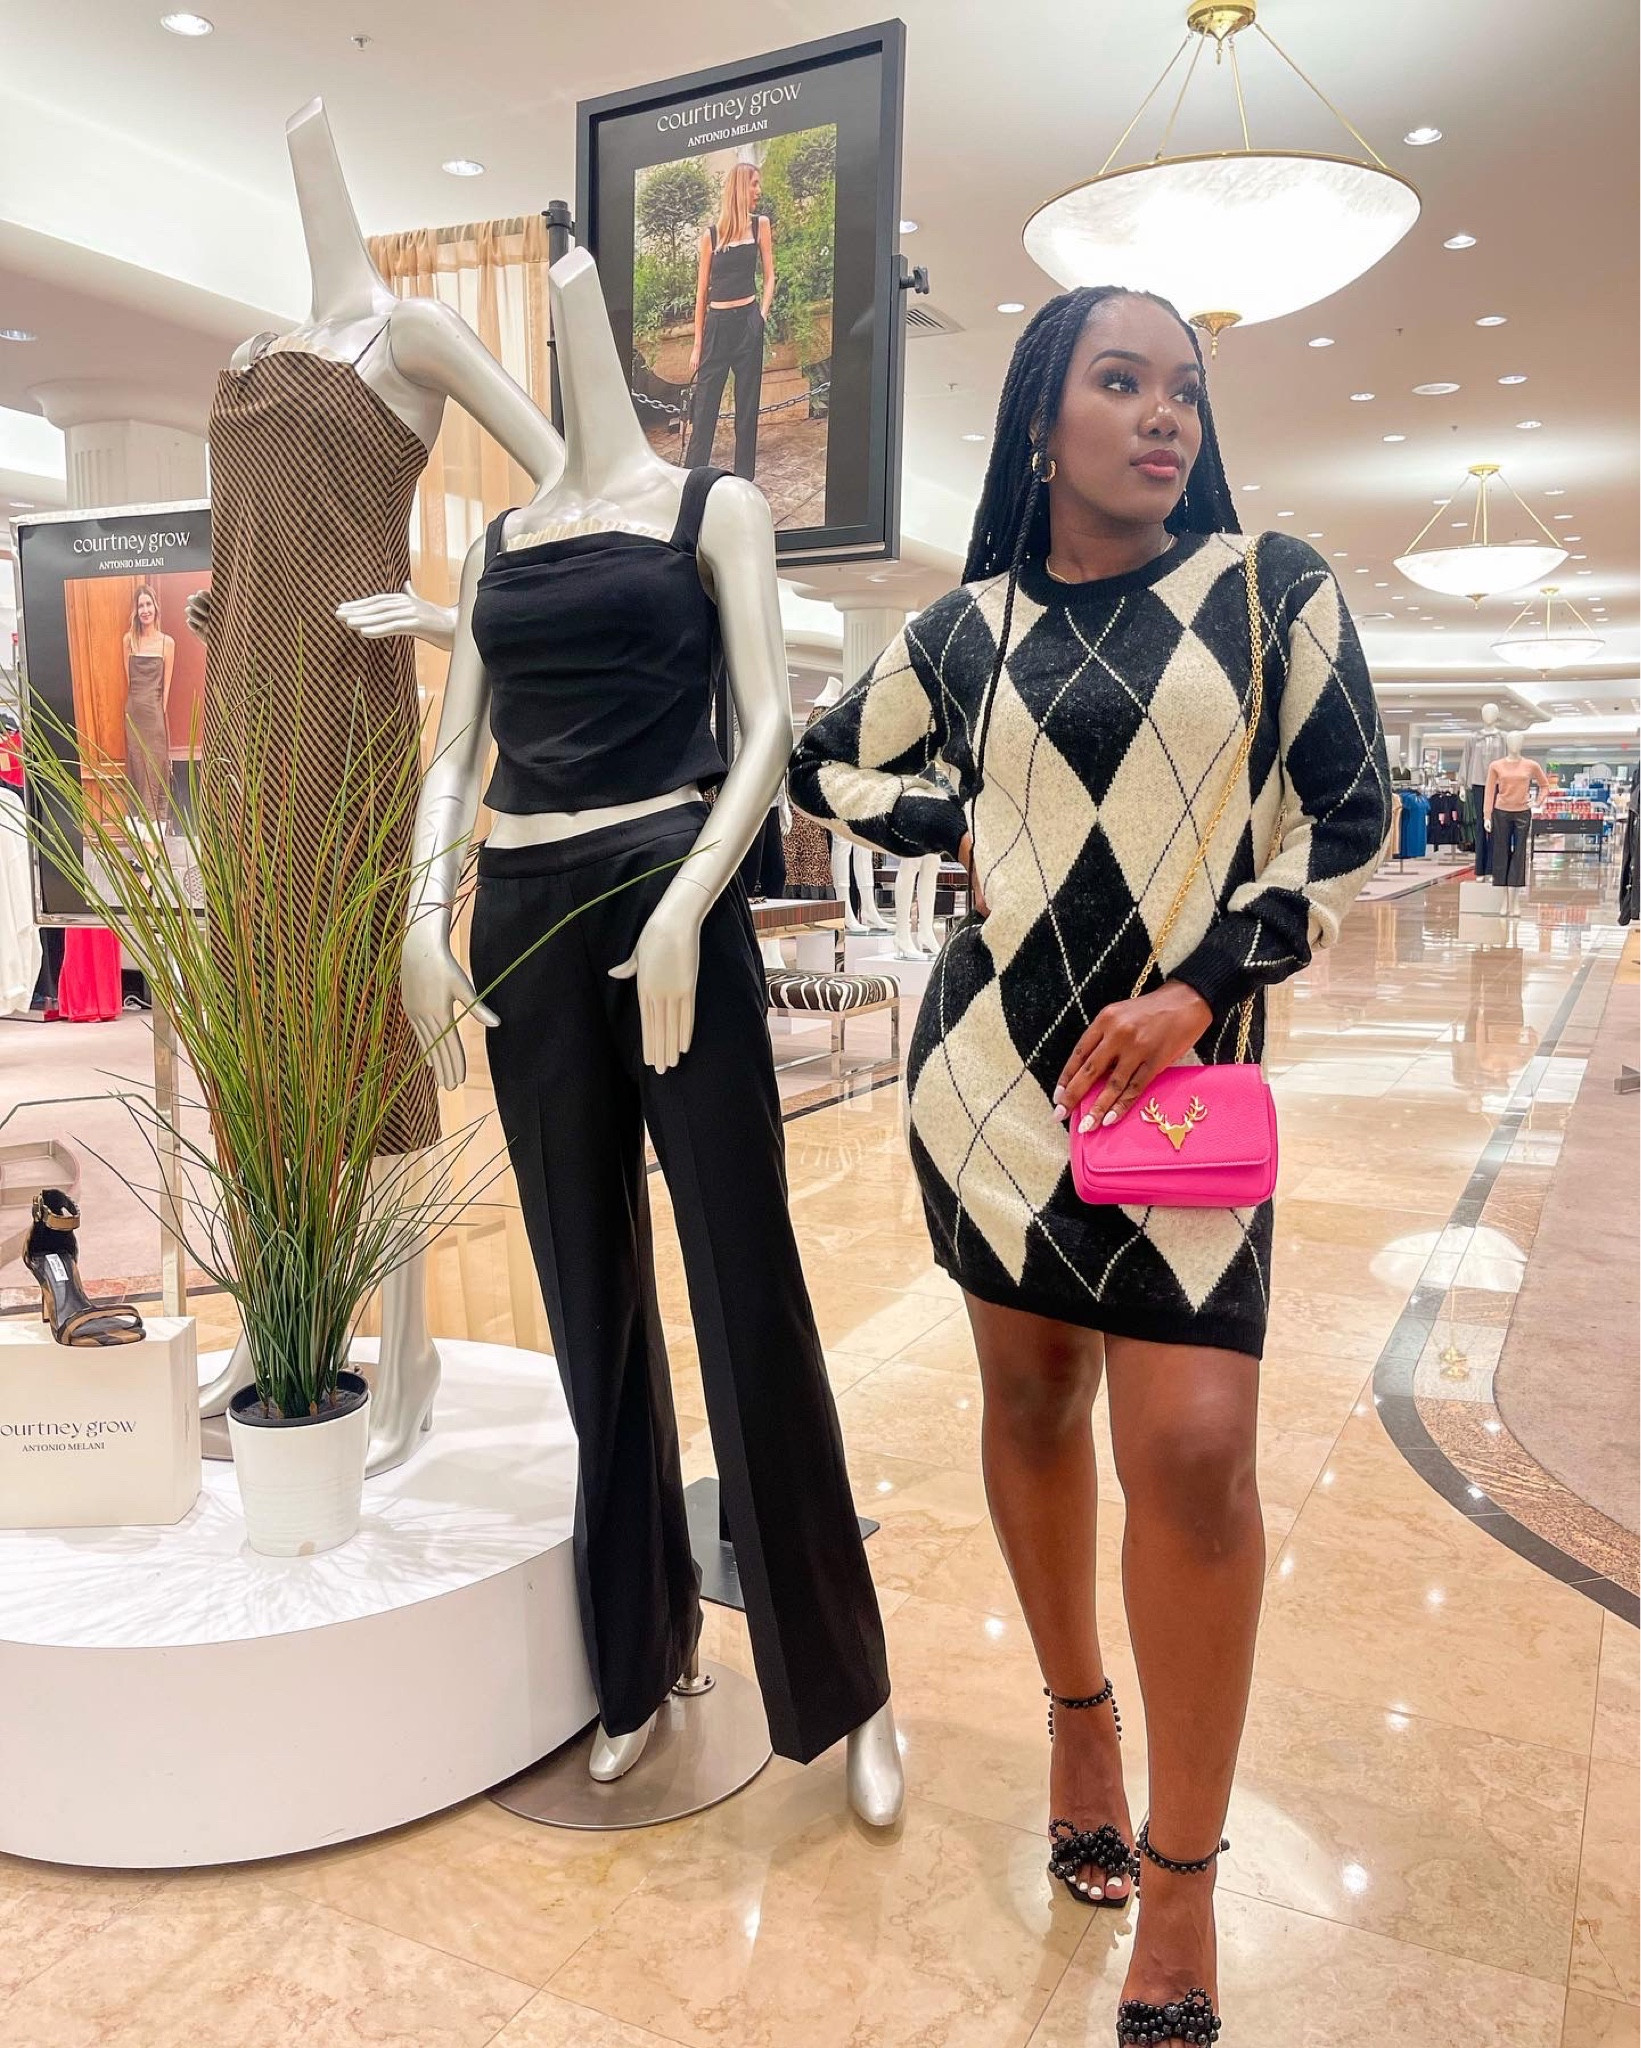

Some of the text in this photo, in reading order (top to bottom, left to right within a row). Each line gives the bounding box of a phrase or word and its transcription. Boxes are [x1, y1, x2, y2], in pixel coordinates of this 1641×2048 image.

[656, 82, 802, 132] courtney grow
[687, 119, 769, 148] ANTONIO MELANI
[73, 531, 190, 554] courtney grow
[98, 557, 164, 571] ANTONIO MELANI
[0, 1420, 137, 1439] ourtney grow
[22, 1441, 105, 1453] ANTONIO MELANI
